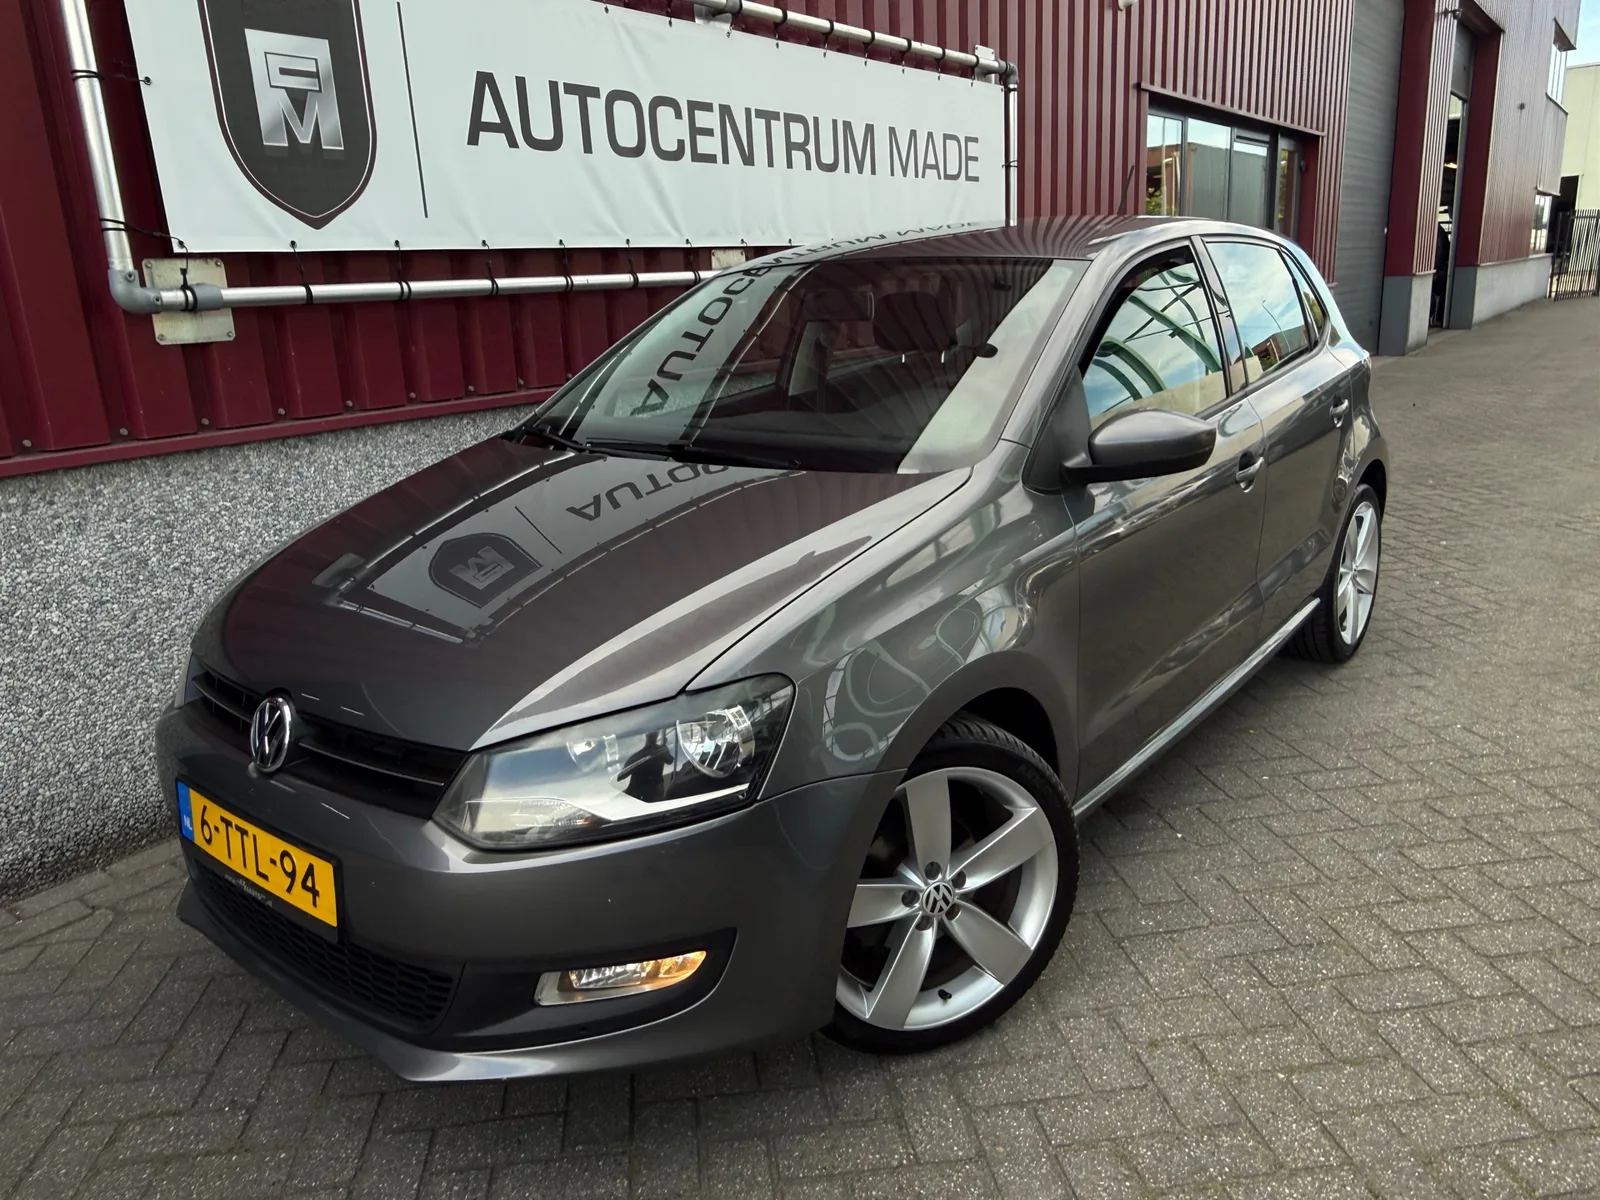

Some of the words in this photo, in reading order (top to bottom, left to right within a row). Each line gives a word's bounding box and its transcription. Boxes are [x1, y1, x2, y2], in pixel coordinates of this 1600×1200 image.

[466, 70, 877, 176] AUTOCENTRUM
[888, 126, 981, 183] MADE
[183, 813, 193, 832] NL
[200, 804, 320, 909] 6-TTL-94
